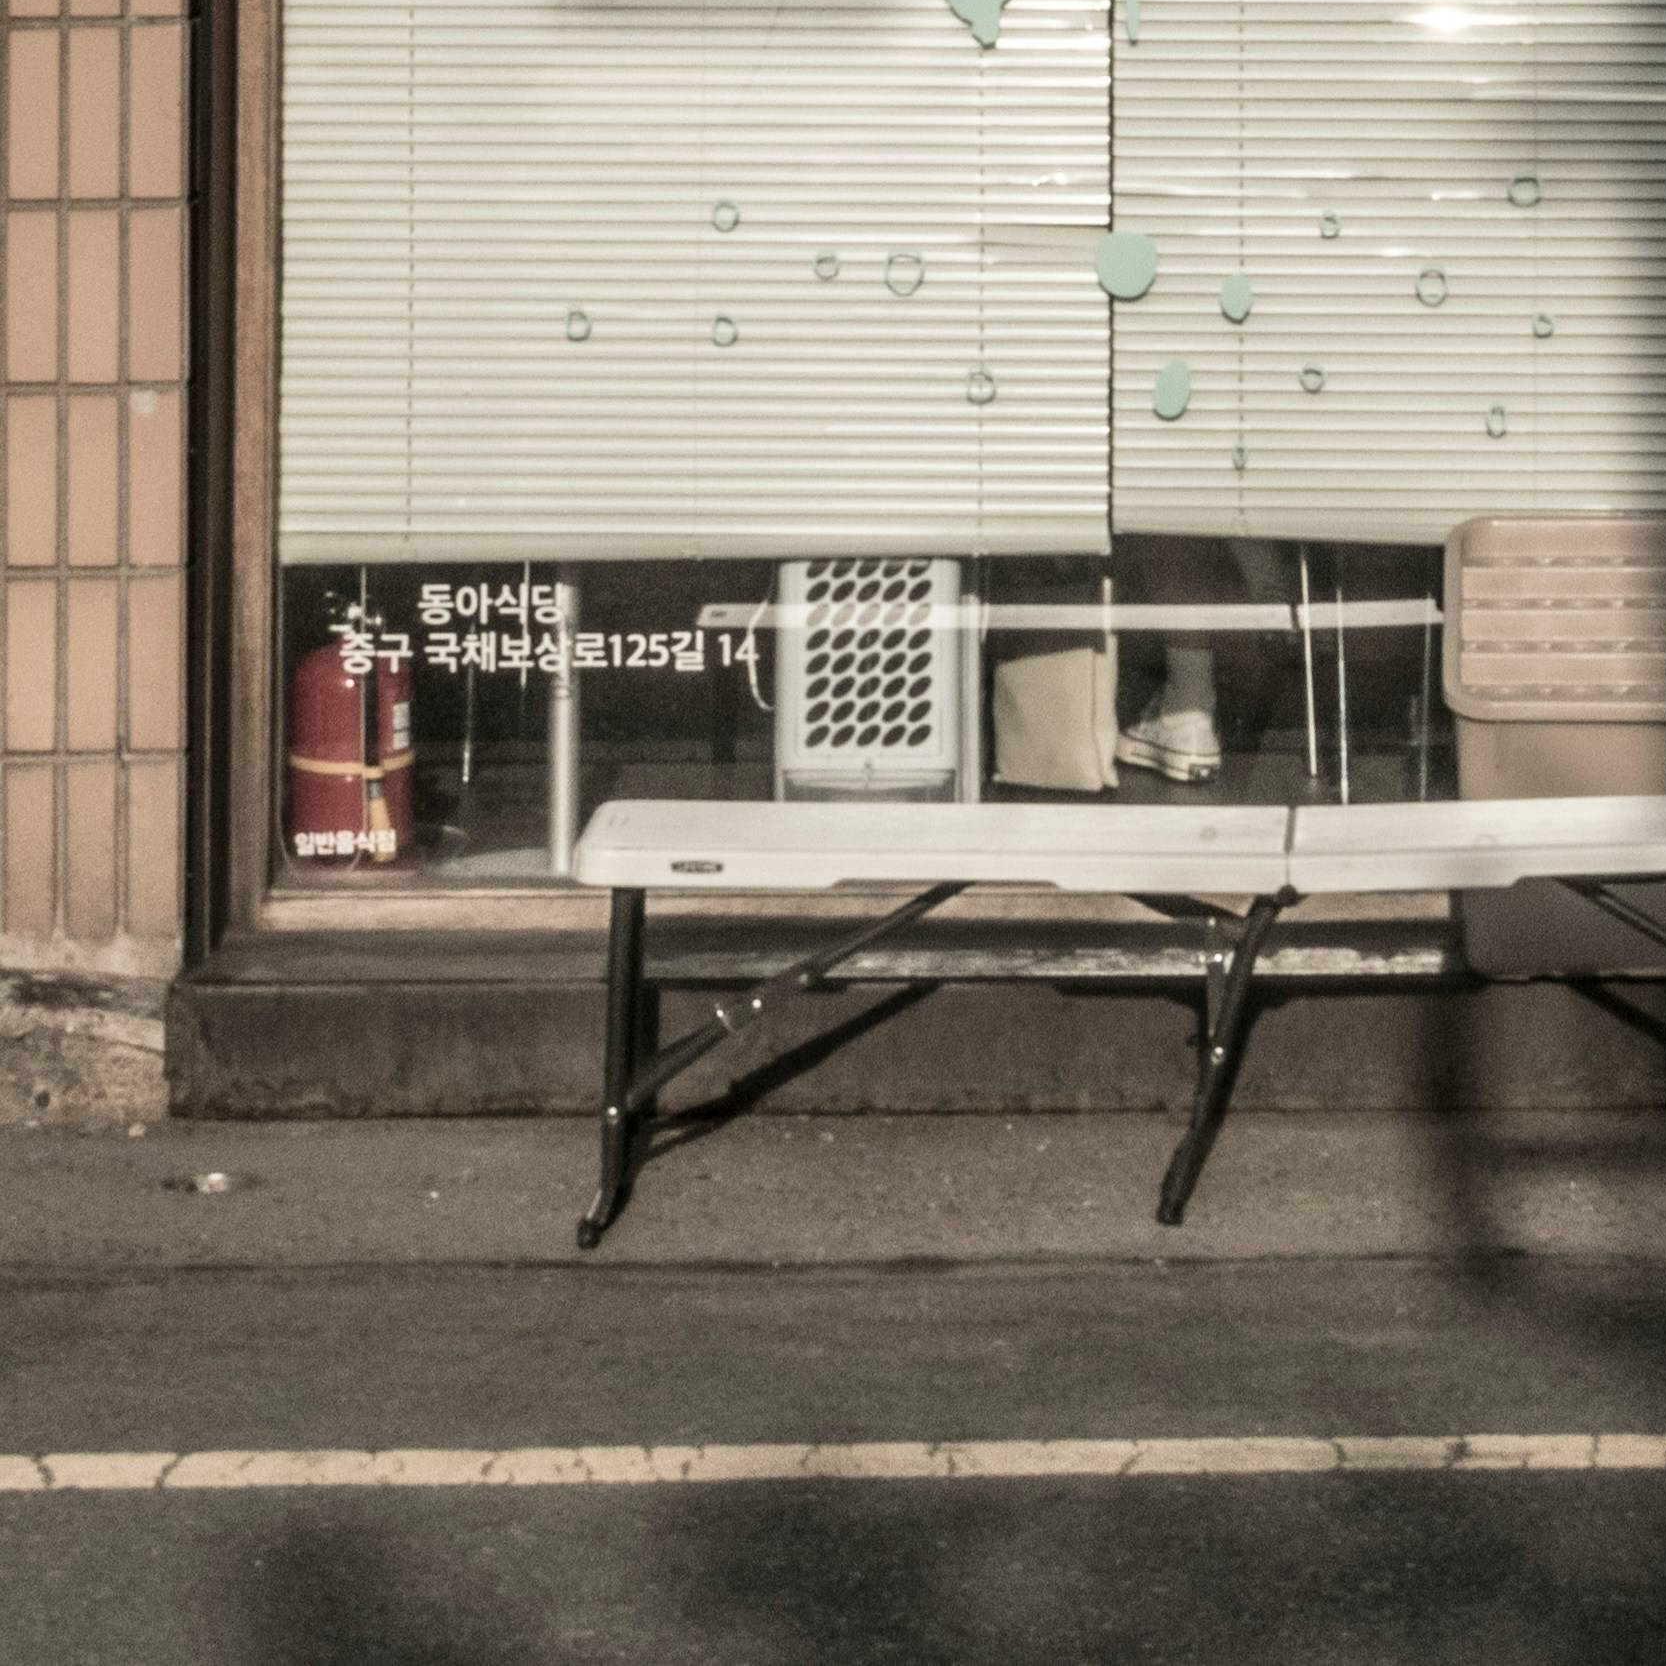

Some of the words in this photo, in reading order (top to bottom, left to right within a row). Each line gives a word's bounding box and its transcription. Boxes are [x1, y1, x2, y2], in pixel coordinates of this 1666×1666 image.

[416, 582, 565, 625] 동아식당
[338, 633, 414, 673] 중구
[423, 630, 706, 673] 국채보상로125길
[718, 633, 760, 667] 14
